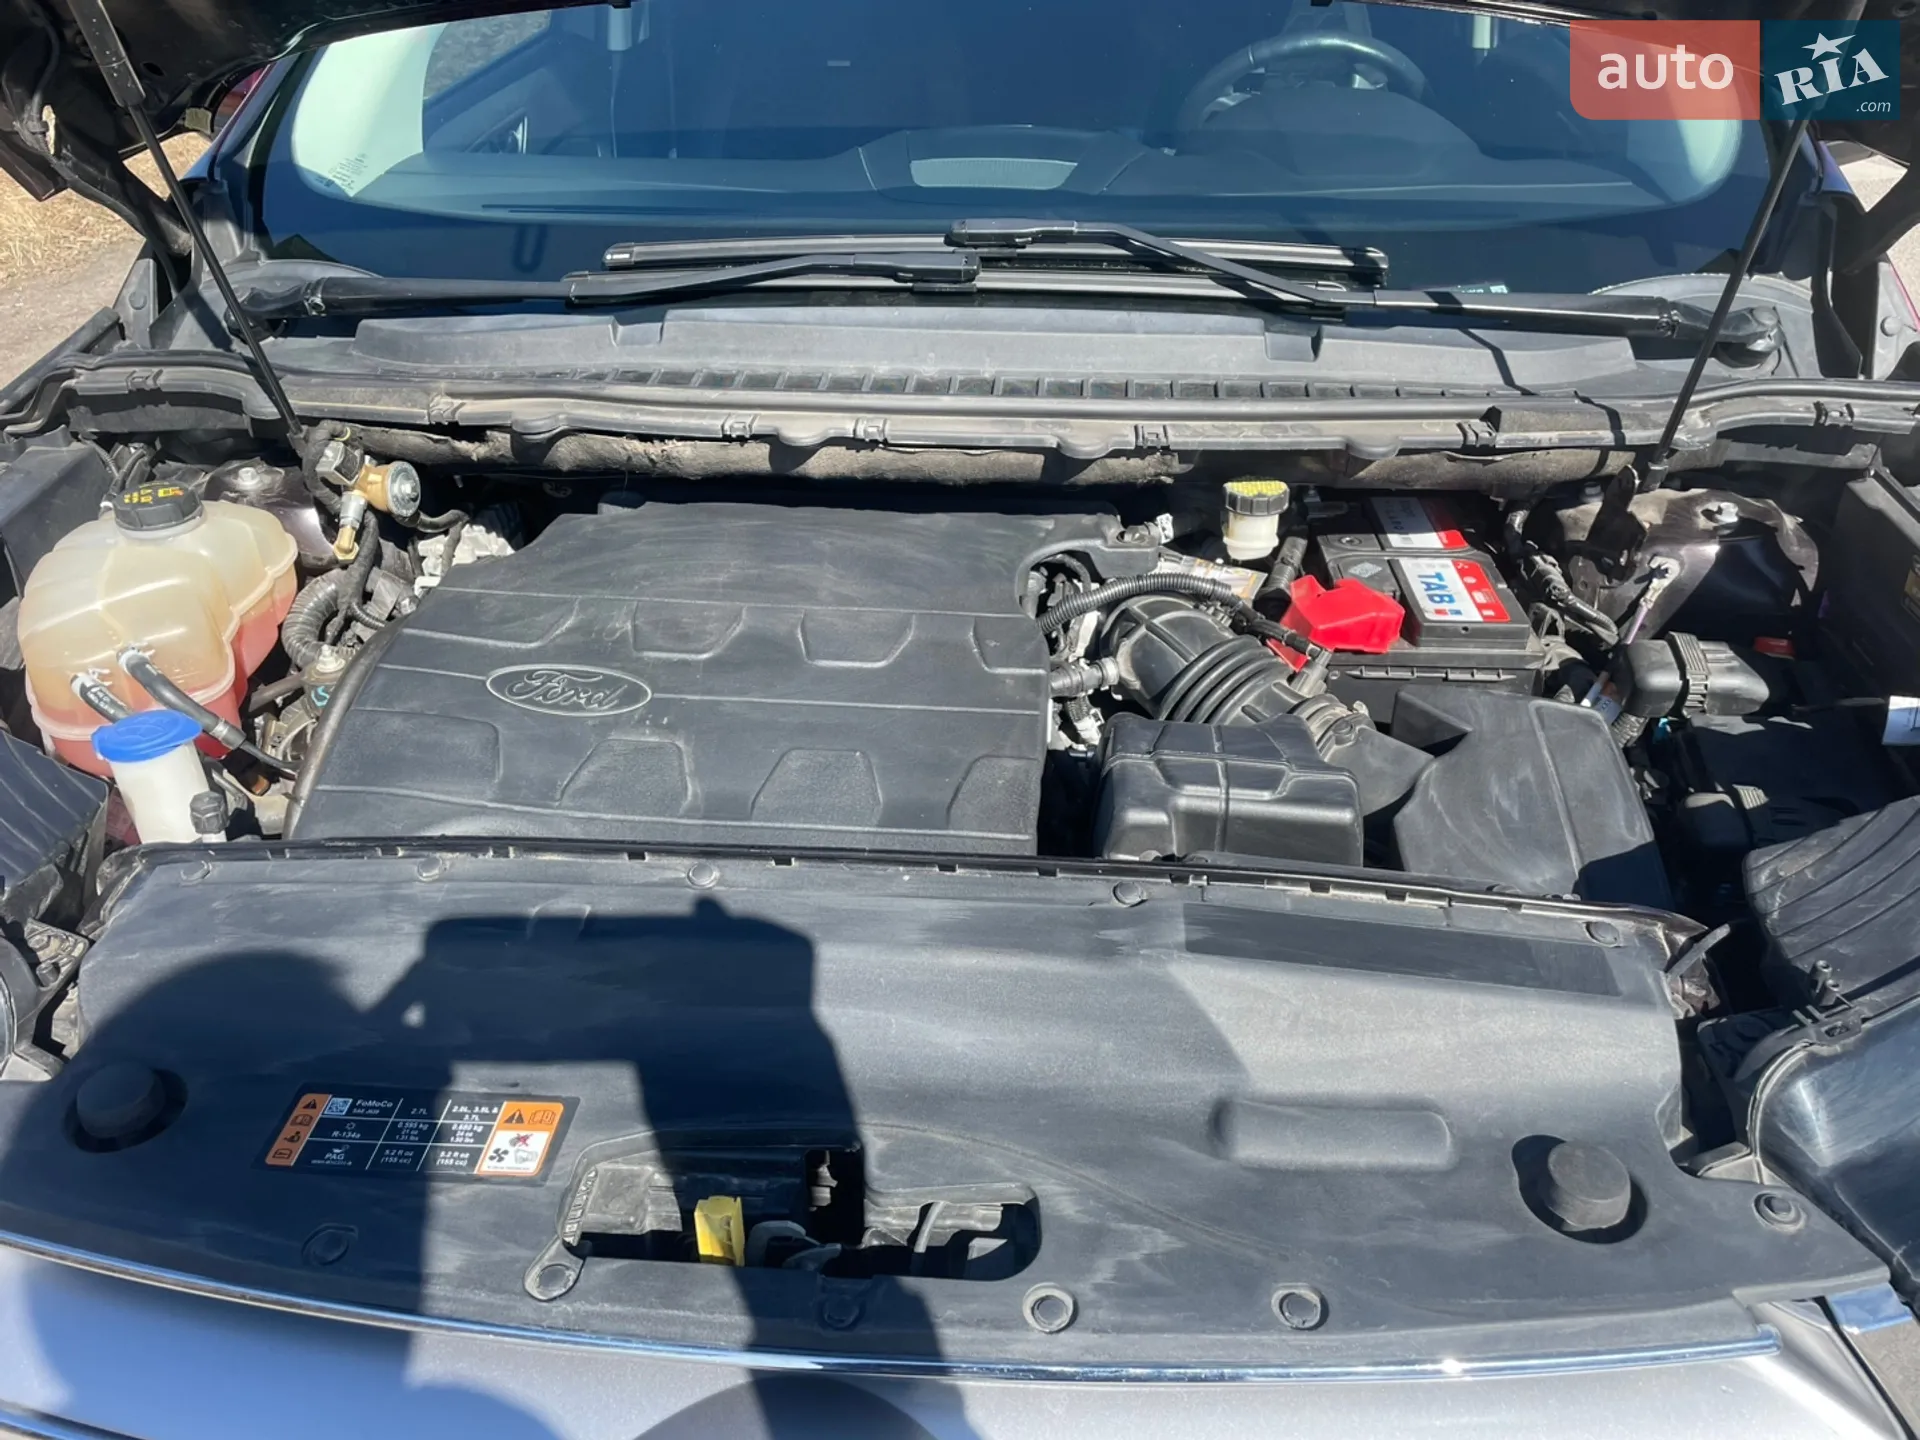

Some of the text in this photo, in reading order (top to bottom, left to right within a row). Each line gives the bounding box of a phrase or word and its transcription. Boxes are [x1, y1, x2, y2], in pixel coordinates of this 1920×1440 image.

[1418, 571, 1456, 604] TAB
[506, 670, 628, 711] Ford
[356, 1099, 393, 1108] FoMoCo
[473, 1124, 484, 1132] kg
